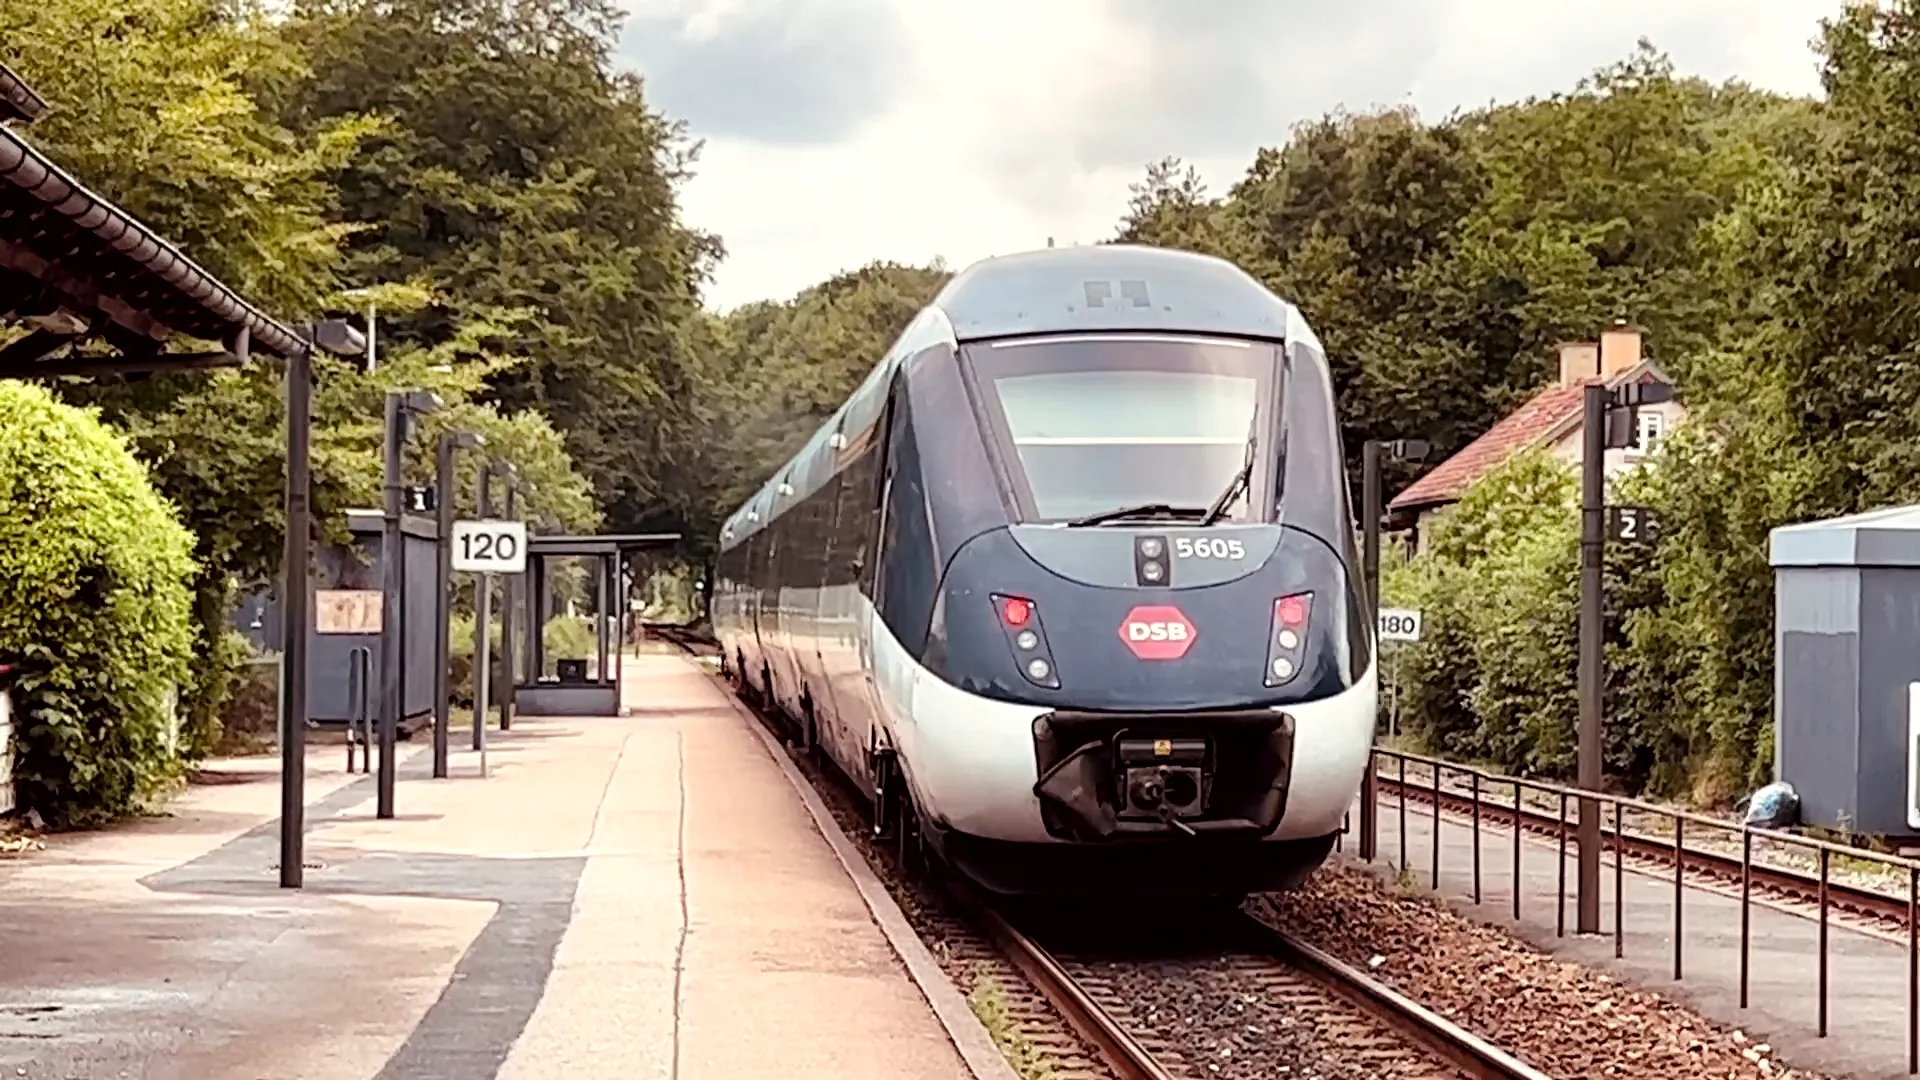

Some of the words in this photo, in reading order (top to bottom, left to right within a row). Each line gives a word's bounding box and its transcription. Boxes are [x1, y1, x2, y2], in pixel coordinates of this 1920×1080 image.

[1620, 516, 1636, 538] 2
[461, 533, 516, 560] 120
[1176, 538, 1245, 559] 5605
[1129, 622, 1187, 641] DSB
[1381, 616, 1415, 634] 180
